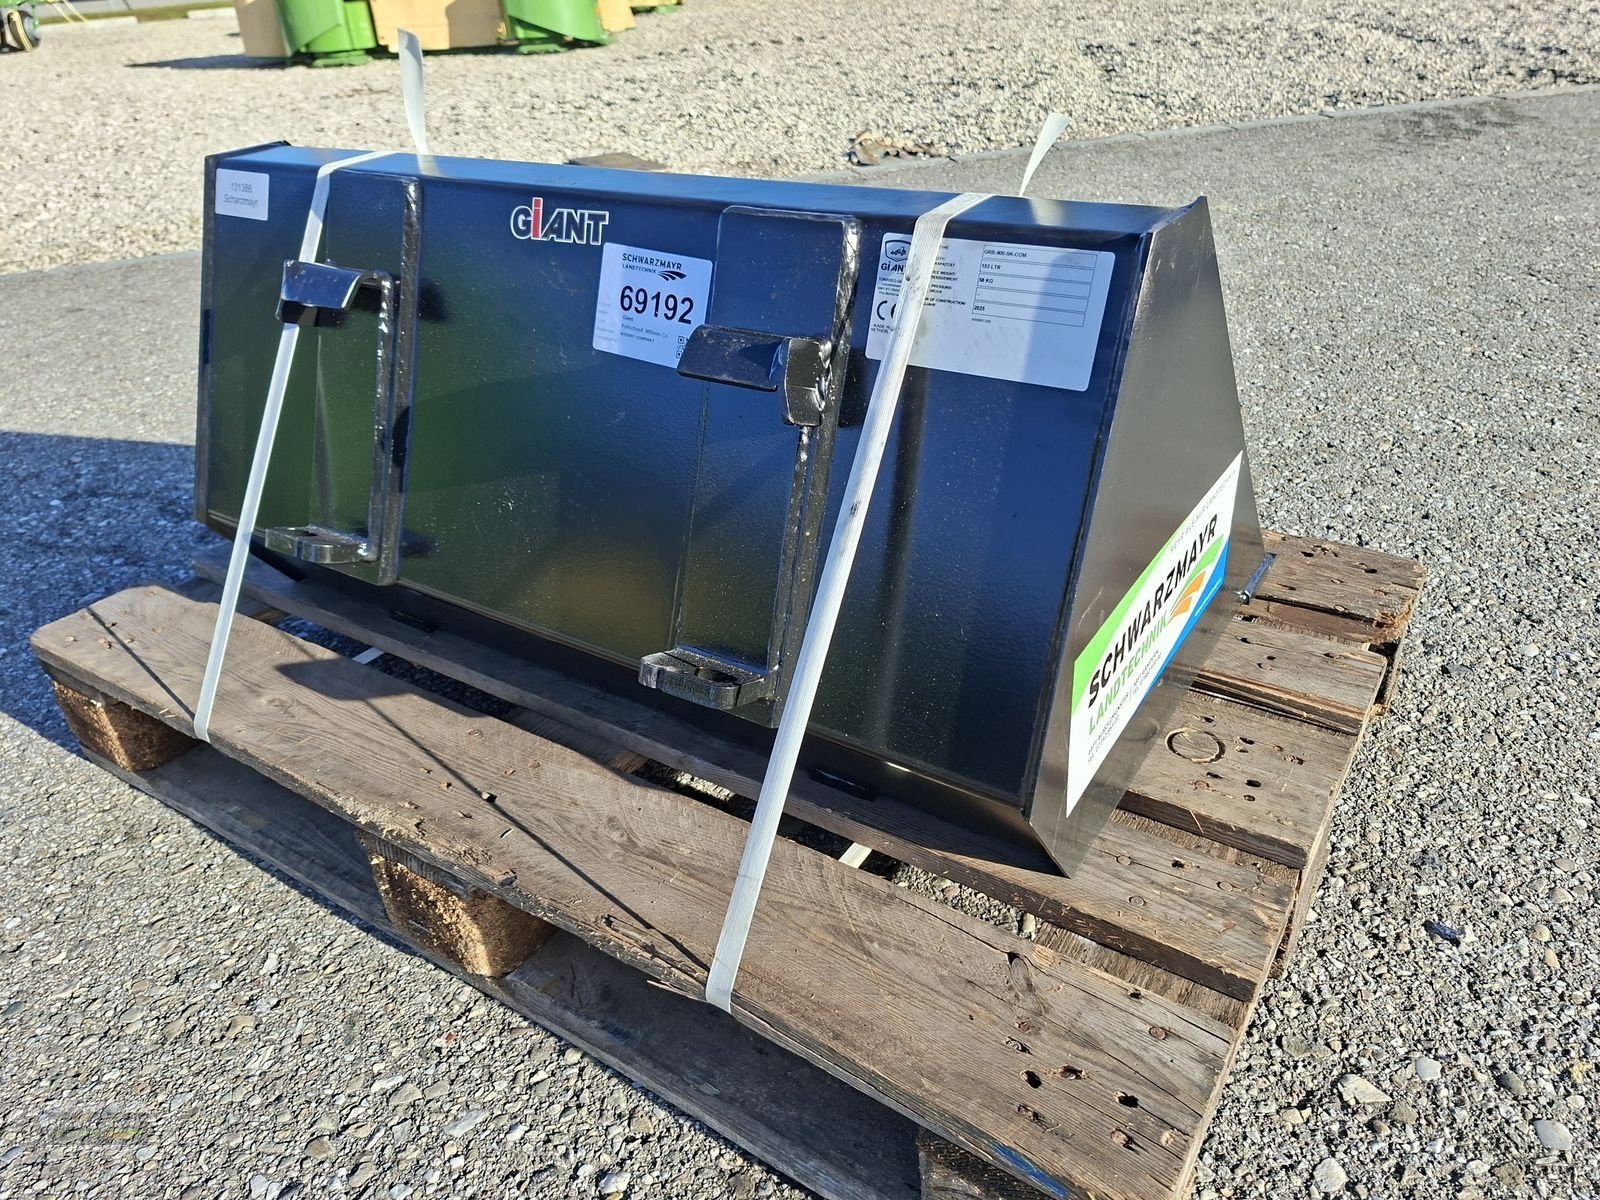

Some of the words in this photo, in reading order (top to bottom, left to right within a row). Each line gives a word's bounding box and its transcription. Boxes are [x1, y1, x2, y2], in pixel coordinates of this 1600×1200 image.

[622, 253, 682, 270] SCHWARZMAYR
[622, 264, 657, 274] LANDTECHNIK
[620, 285, 694, 325] 69192
[1087, 513, 1218, 709] SCHWARZMAYR
[1088, 608, 1169, 736] LANDTECHNIK
